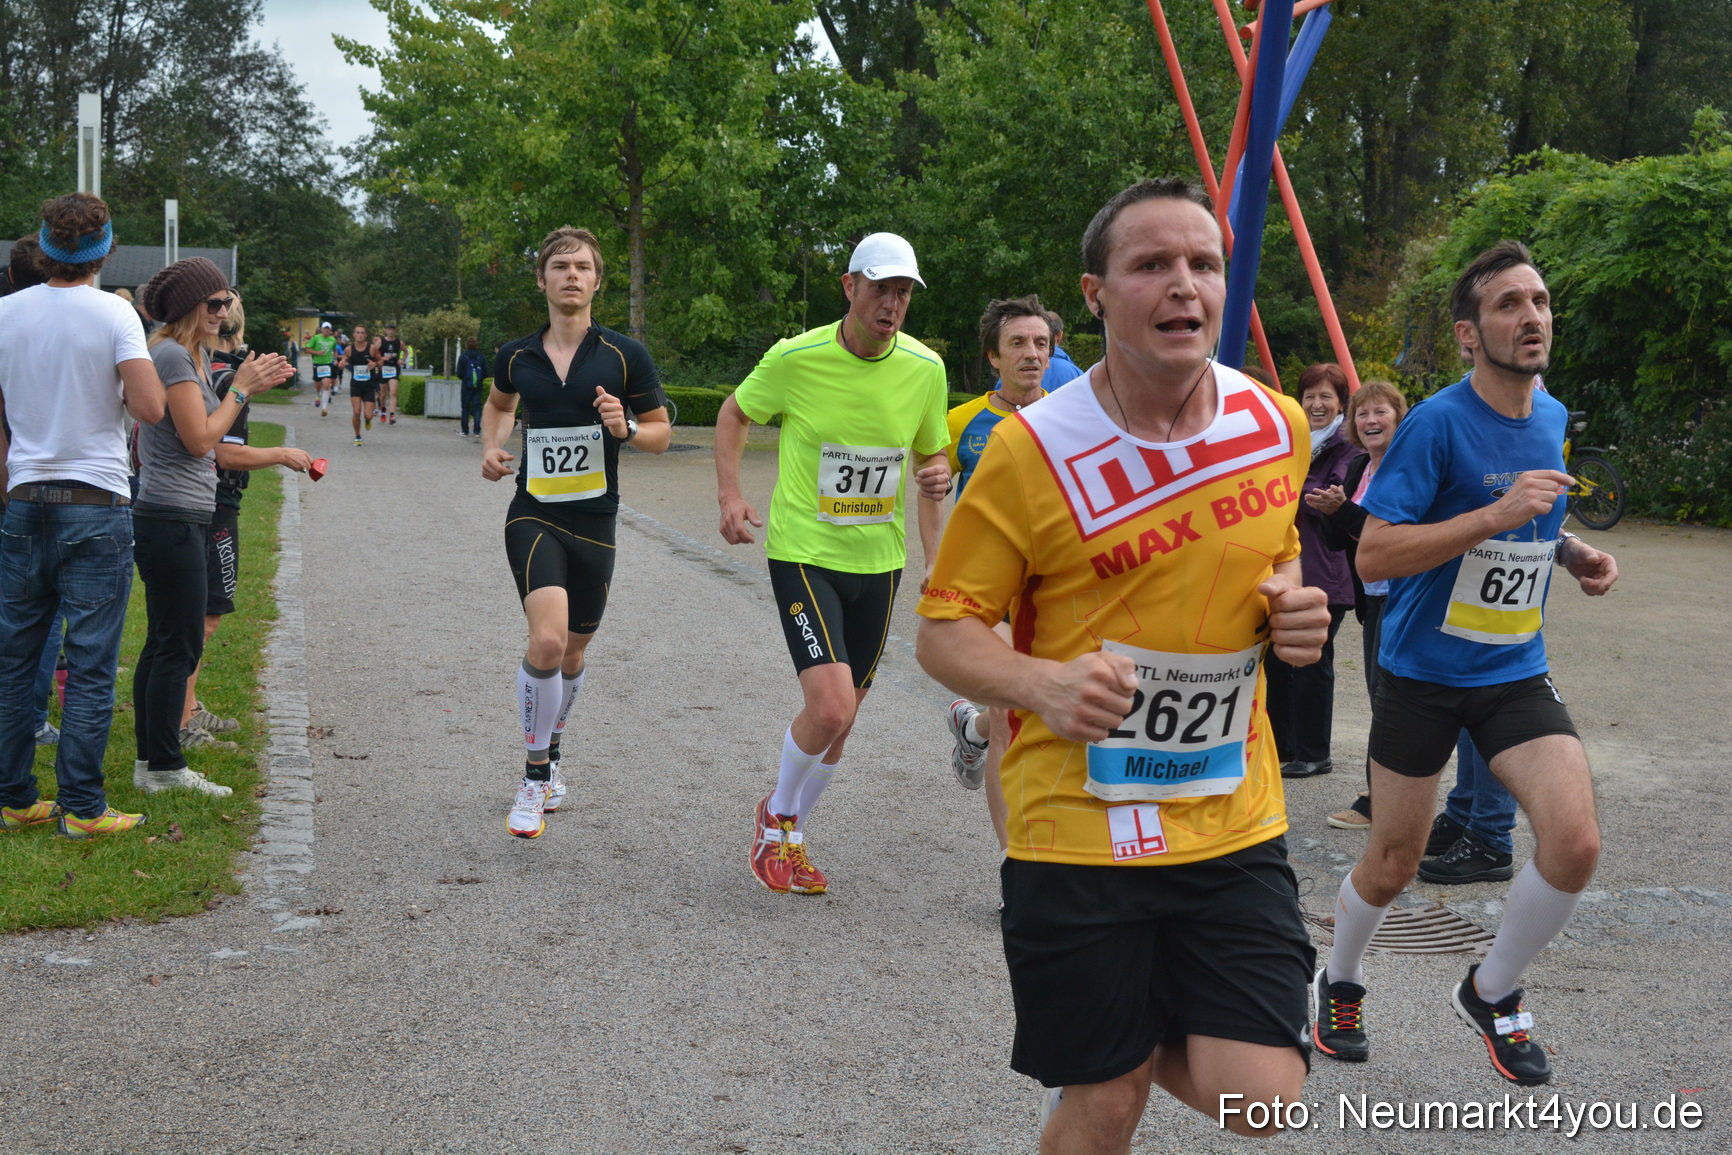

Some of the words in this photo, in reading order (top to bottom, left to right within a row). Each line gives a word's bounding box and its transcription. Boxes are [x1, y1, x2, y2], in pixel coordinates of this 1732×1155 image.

[528, 436, 550, 444] PARTL
[551, 434, 590, 443] Neumarkt
[542, 445, 589, 474] 622
[822, 451, 853, 462] PARTL
[854, 454, 893, 463] Neumarkt
[835, 465, 888, 494] 317
[833, 502, 883, 516] Christoph
[1090, 510, 1203, 580] MAX
[1210, 474, 1298, 530] BÖGL
[1468, 547, 1506, 562] PARTL
[1507, 552, 1547, 563] Neumarkt
[1480, 566, 1539, 605] 621
[794, 612, 824, 659] SKINS
[1166, 667, 1241, 683] Neumarkt
[1107, 685, 1241, 744] 2621
[1124, 755, 1209, 779] Michael
